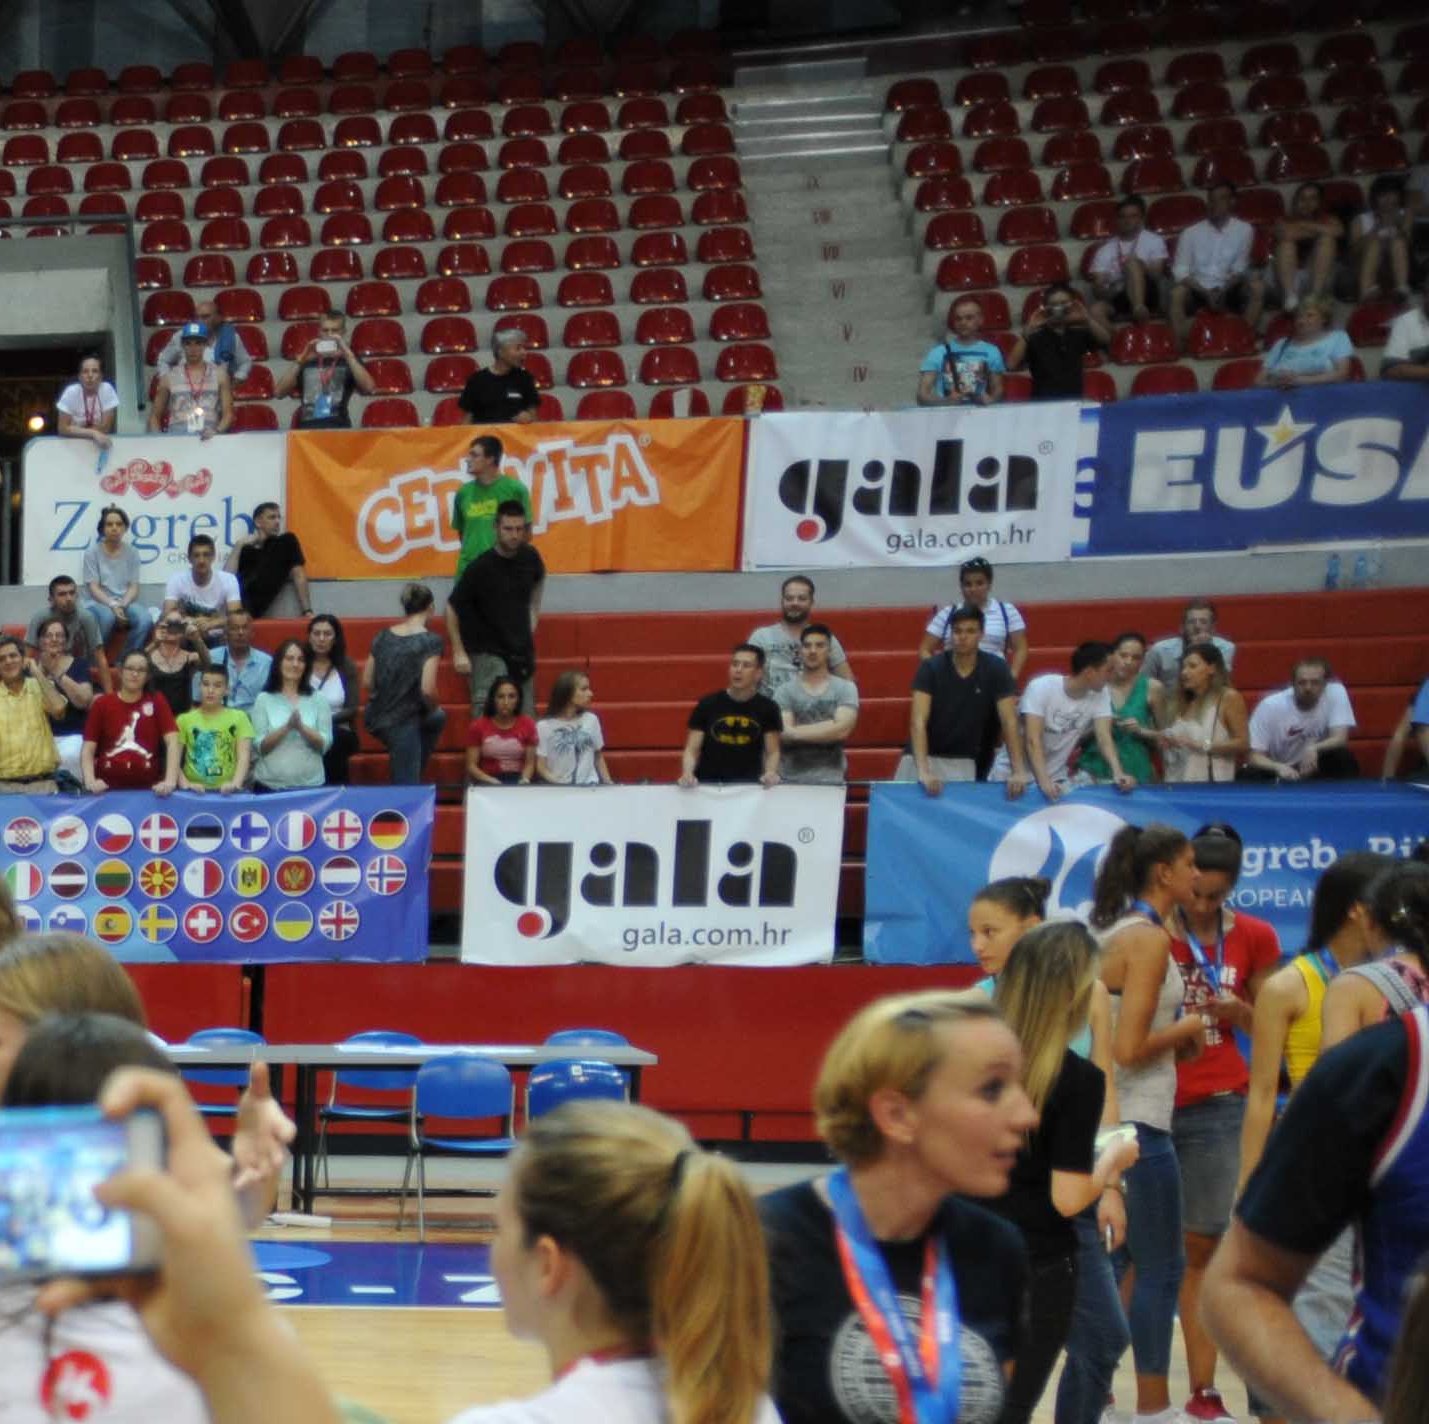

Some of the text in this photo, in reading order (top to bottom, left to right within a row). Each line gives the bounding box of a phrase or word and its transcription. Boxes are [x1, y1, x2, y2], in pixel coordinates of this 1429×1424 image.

[778, 438, 1039, 543] gala
[1129, 412, 1429, 513] EUS
[49, 496, 255, 564] Zgreb
[887, 525, 1036, 553] gala.com.hr
[494, 819, 798, 940] gala
[1242, 838, 1337, 877] greb
[622, 921, 792, 951] gala.com.hr
